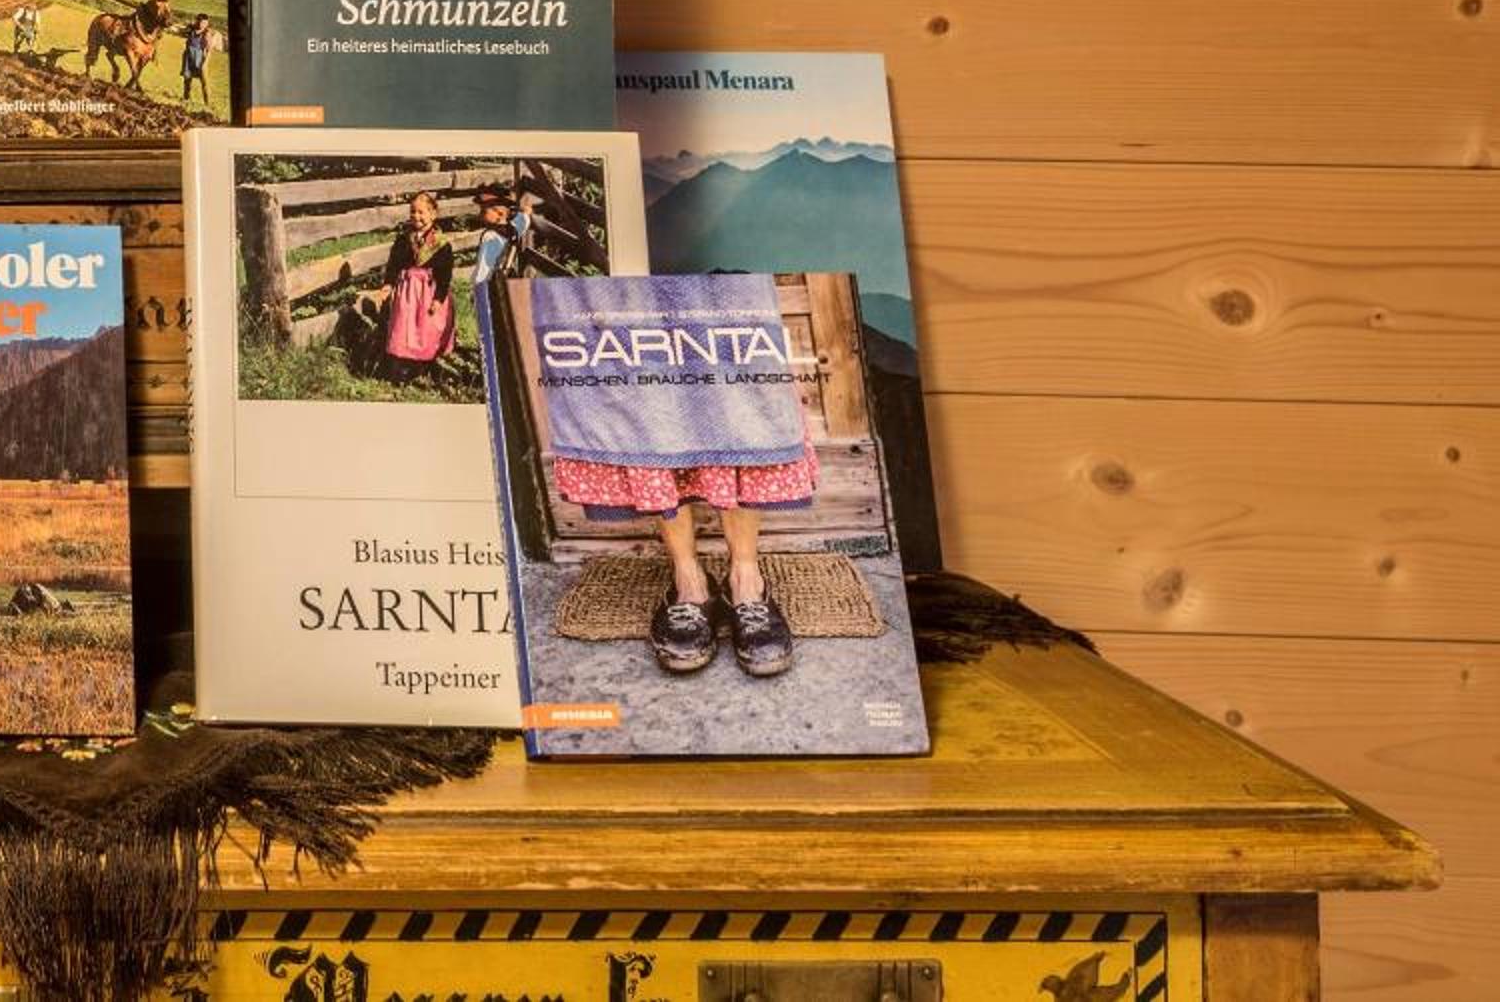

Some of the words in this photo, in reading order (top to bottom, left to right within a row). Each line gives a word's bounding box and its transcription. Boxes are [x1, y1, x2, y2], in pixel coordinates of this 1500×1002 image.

[307, 38, 329, 53] Ein
[332, 38, 388, 54] heiteres
[391, 38, 481, 54] heimatliches
[484, 39, 549, 55] Lesebuch
[705, 70, 795, 90] Menara
[543, 327, 821, 368] SARNTAL
[537, 374, 629, 388] MENSCHEN
[725, 372, 831, 385] LANDSCHAFT
[353, 539, 439, 565] Blasius
[375, 662, 501, 695] Tappeiner
